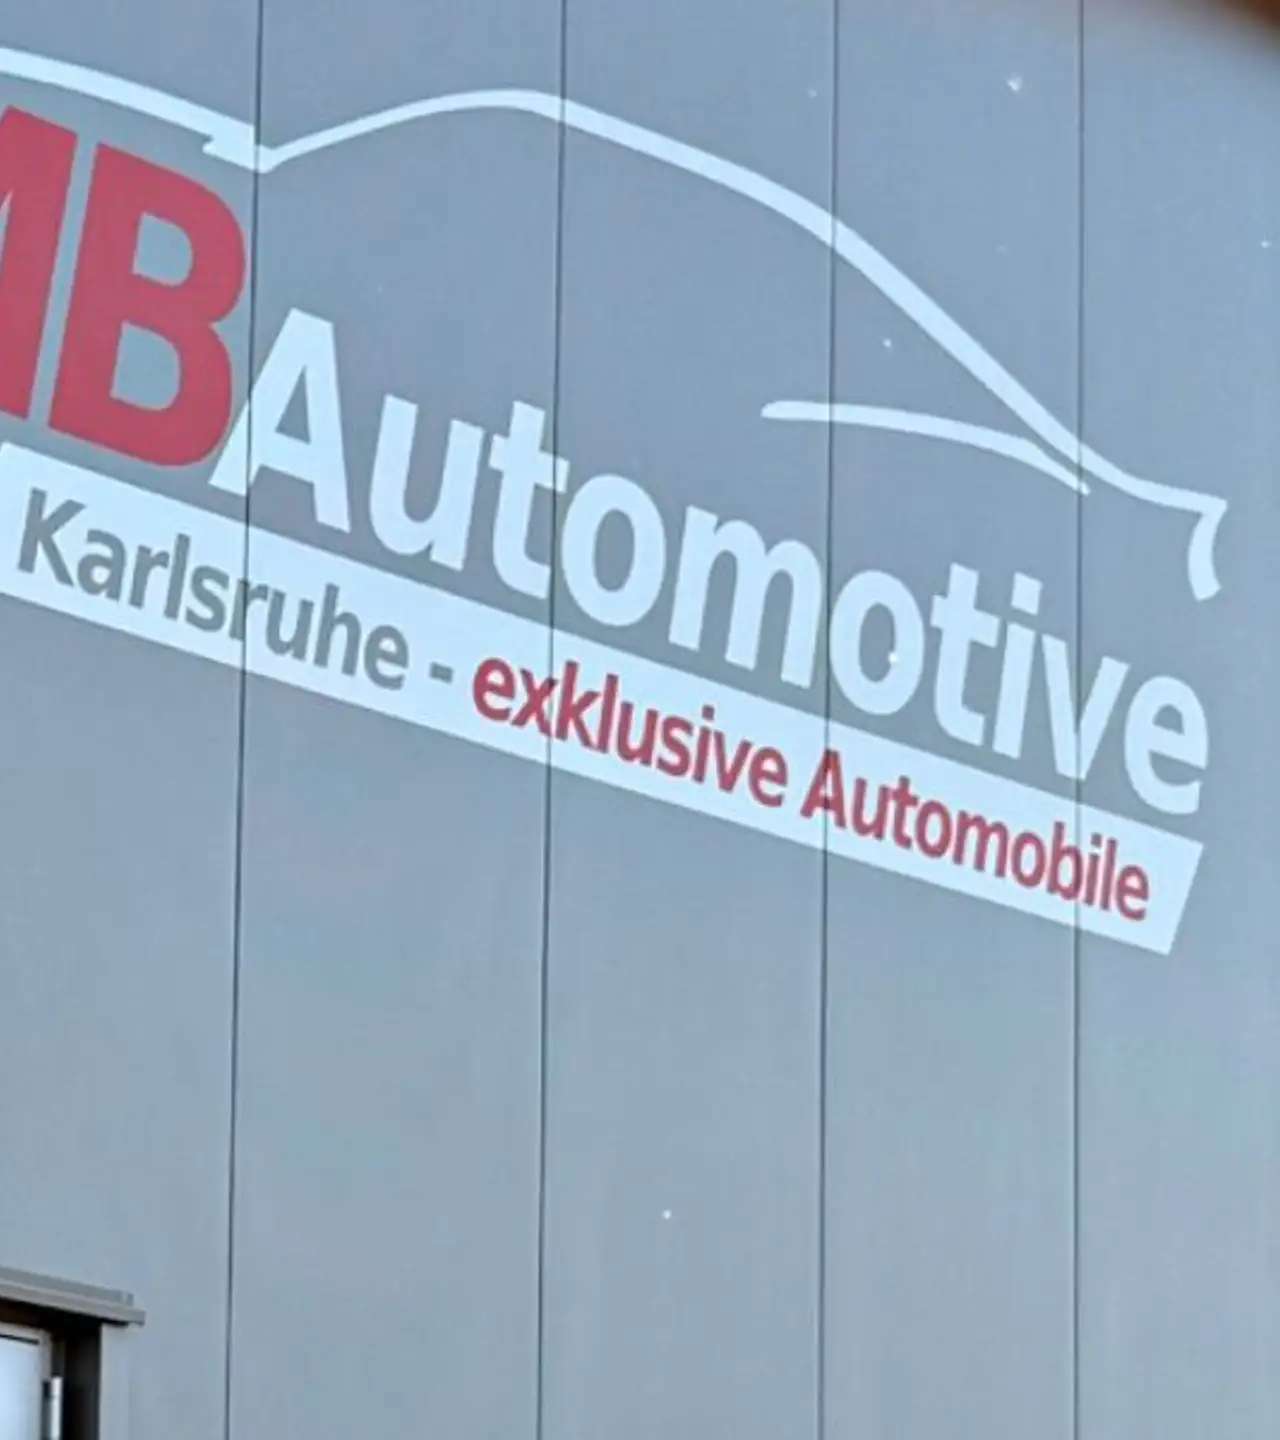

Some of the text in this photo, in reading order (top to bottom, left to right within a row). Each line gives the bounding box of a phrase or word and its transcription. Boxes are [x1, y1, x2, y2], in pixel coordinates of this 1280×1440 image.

[17, 486, 1151, 921] Karlsruhe - exklusive Automobile
